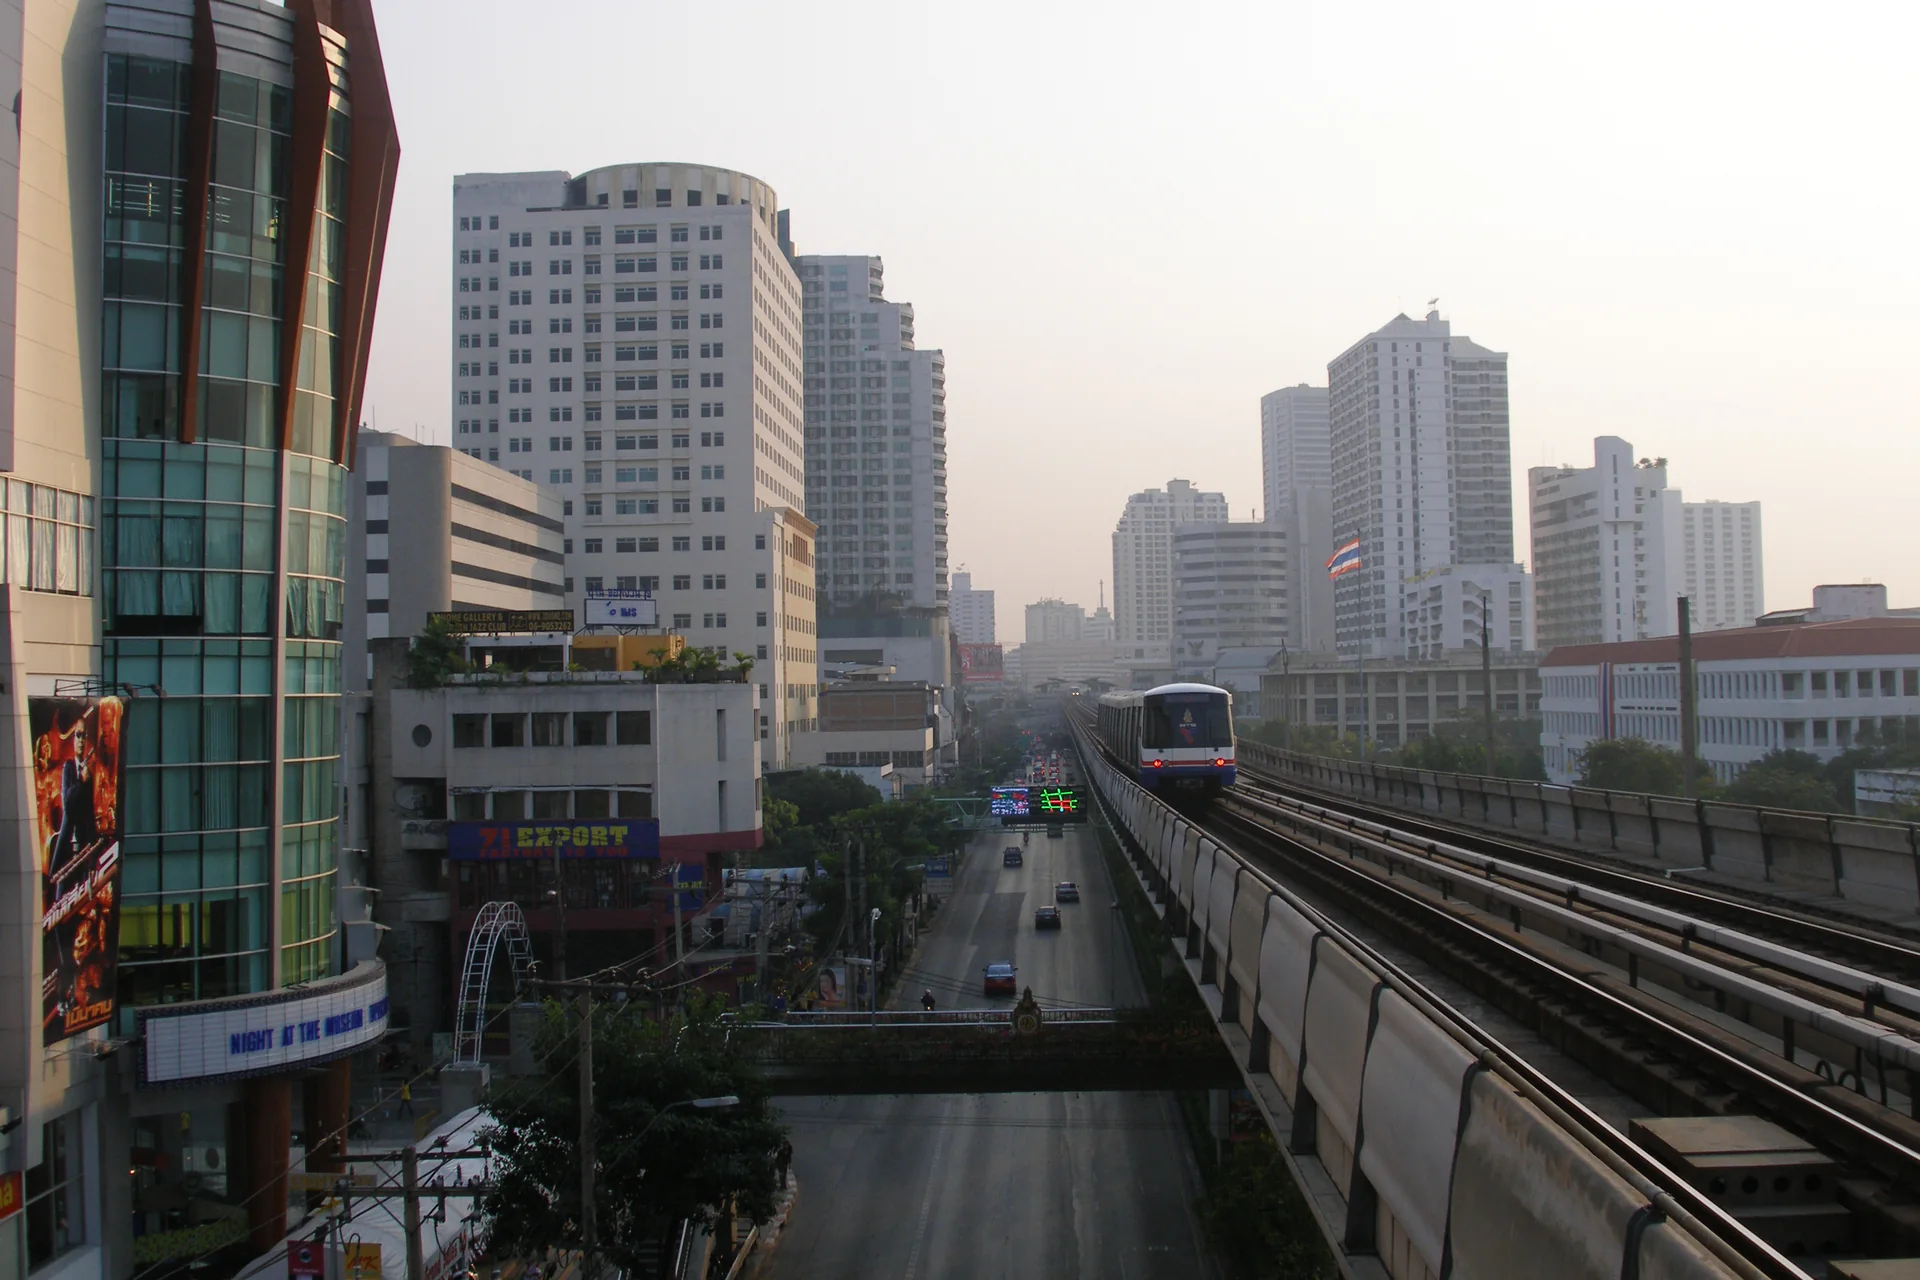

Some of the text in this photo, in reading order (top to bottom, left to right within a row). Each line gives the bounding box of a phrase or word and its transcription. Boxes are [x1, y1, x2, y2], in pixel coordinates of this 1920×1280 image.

[463, 612, 496, 622] GALLERY
[469, 623, 487, 632] JAZZ
[488, 622, 507, 632] CLUB
[517, 825, 628, 848] EXPORT
[479, 847, 555, 858] FACTORY
[566, 847, 586, 857] TO
[231, 1028, 274, 1055] NIGHT
[282, 1025, 295, 1047] AT
[299, 1020, 321, 1043] THE
